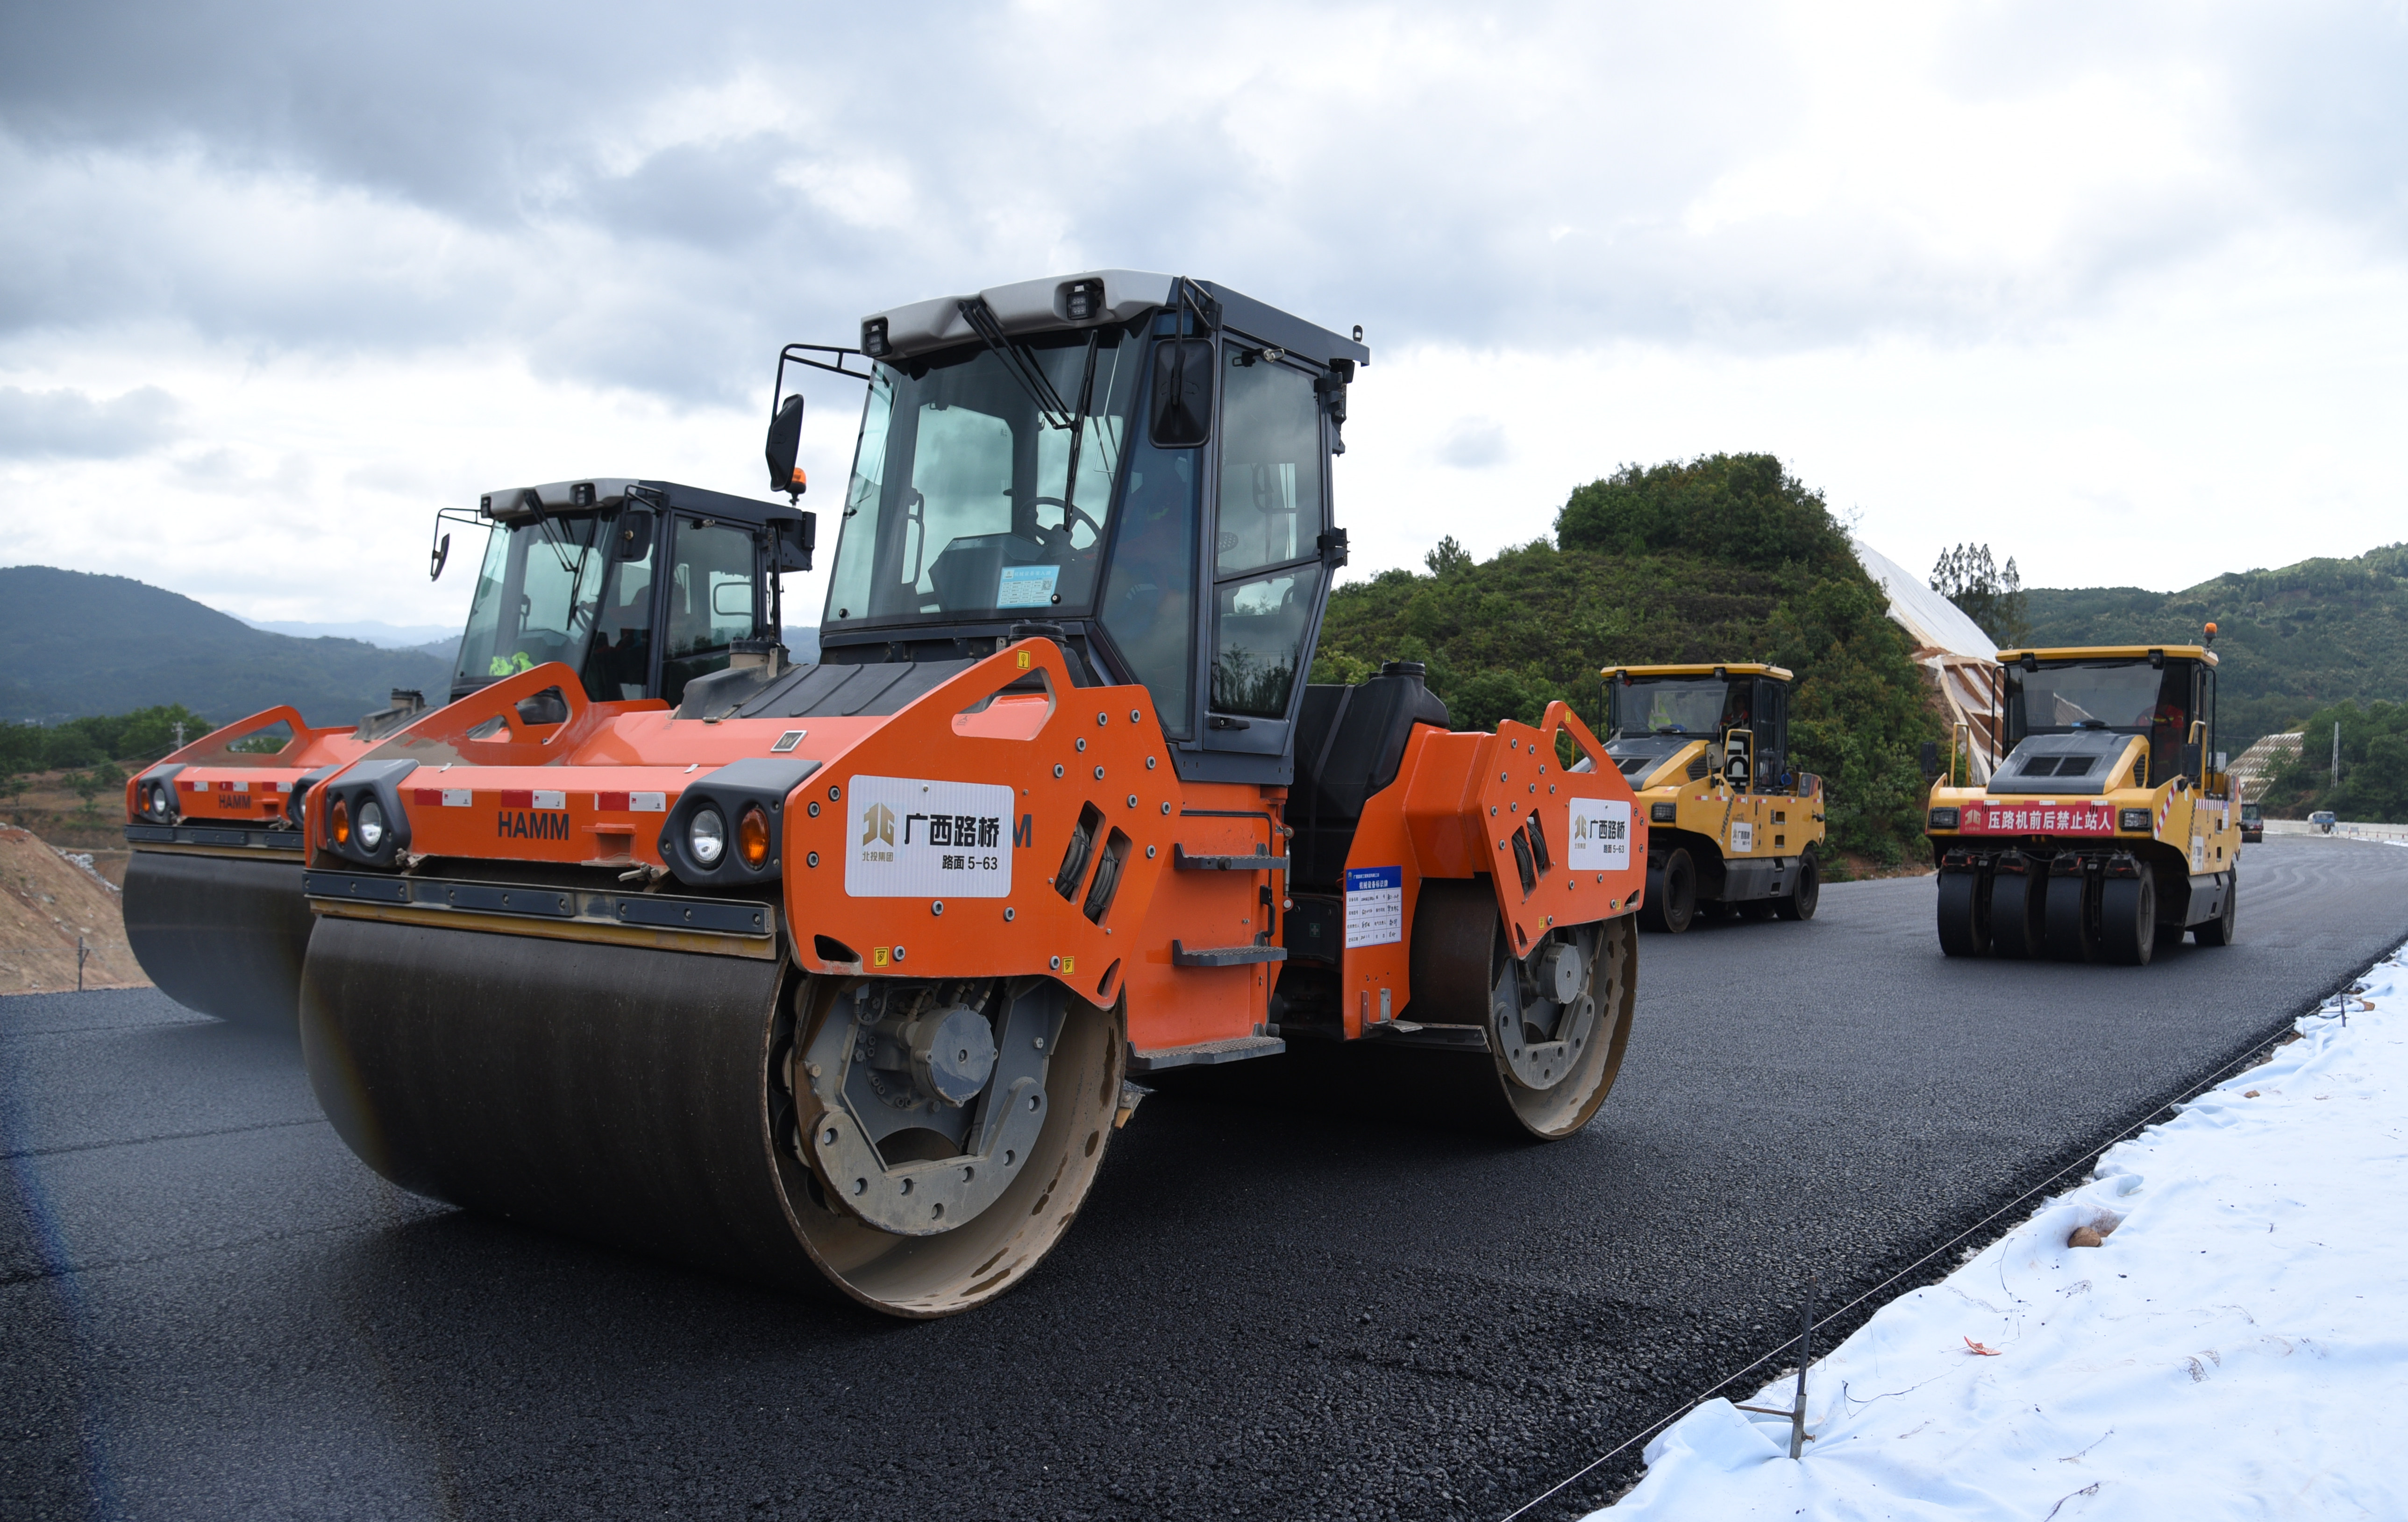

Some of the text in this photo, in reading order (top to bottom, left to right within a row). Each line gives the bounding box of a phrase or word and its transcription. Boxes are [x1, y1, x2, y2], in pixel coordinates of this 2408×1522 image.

[219, 794, 251, 810] HAMM
[498, 811, 569, 840] HAMM
[1589, 819, 1625, 839] 广西路桥
[1988, 811, 2111, 830] 压路机前后禁止站人
[904, 813, 1000, 848] 广西路桥
[862, 851, 894, 862] 北投集团
[1613, 845, 1624, 853] 5-63
[942, 855, 998, 870] 路面 5-63
